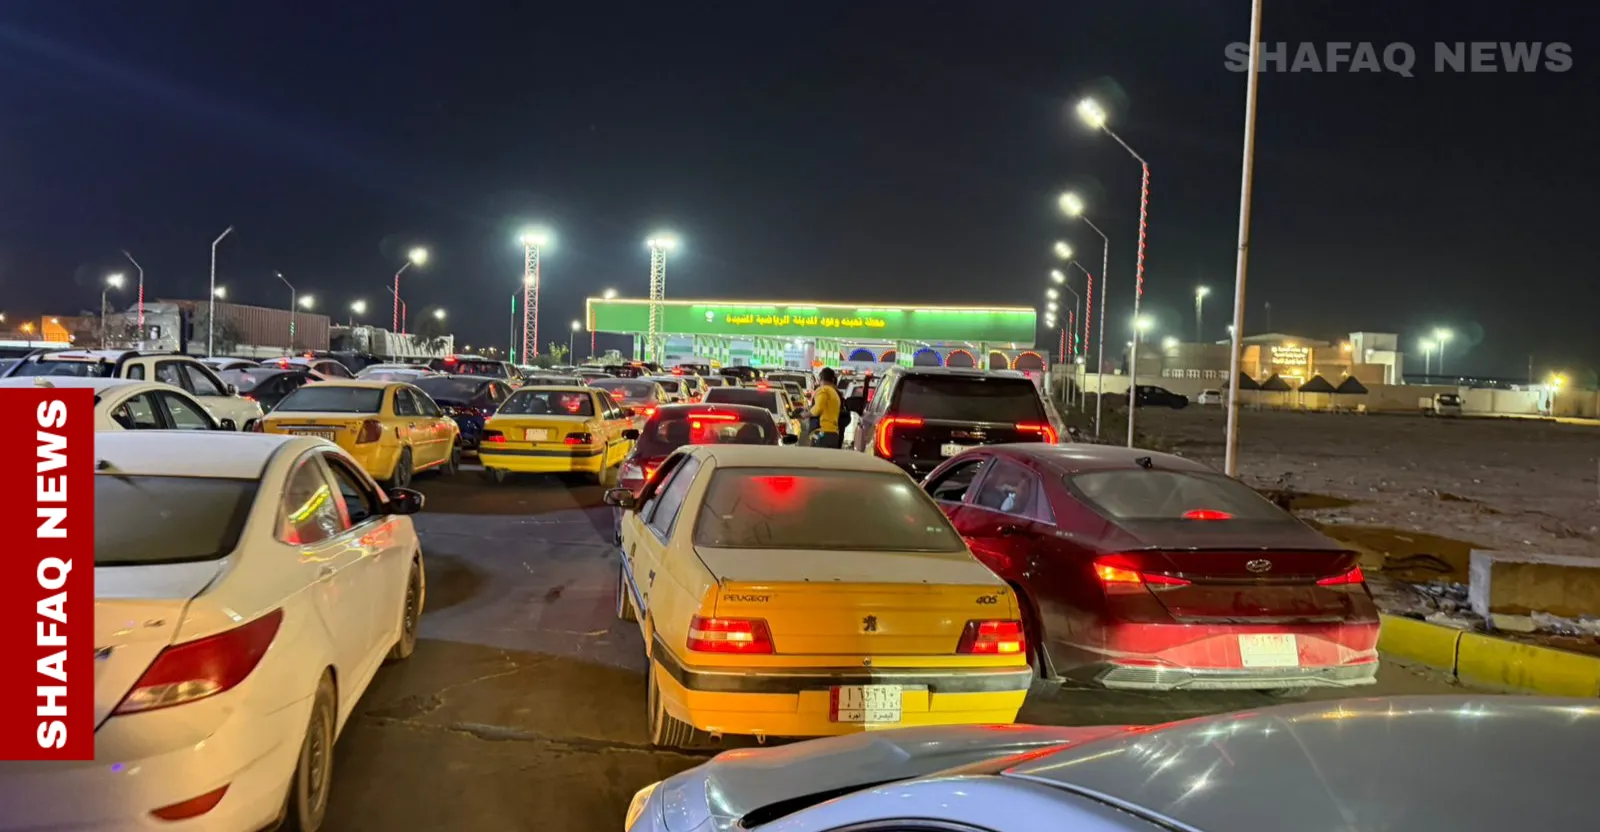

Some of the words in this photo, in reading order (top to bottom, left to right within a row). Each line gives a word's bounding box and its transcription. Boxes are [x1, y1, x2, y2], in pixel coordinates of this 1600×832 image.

[756, 313, 790, 326] الرياضية
[723, 594, 773, 603] PEUGEOT
[976, 594, 998, 605] 405
